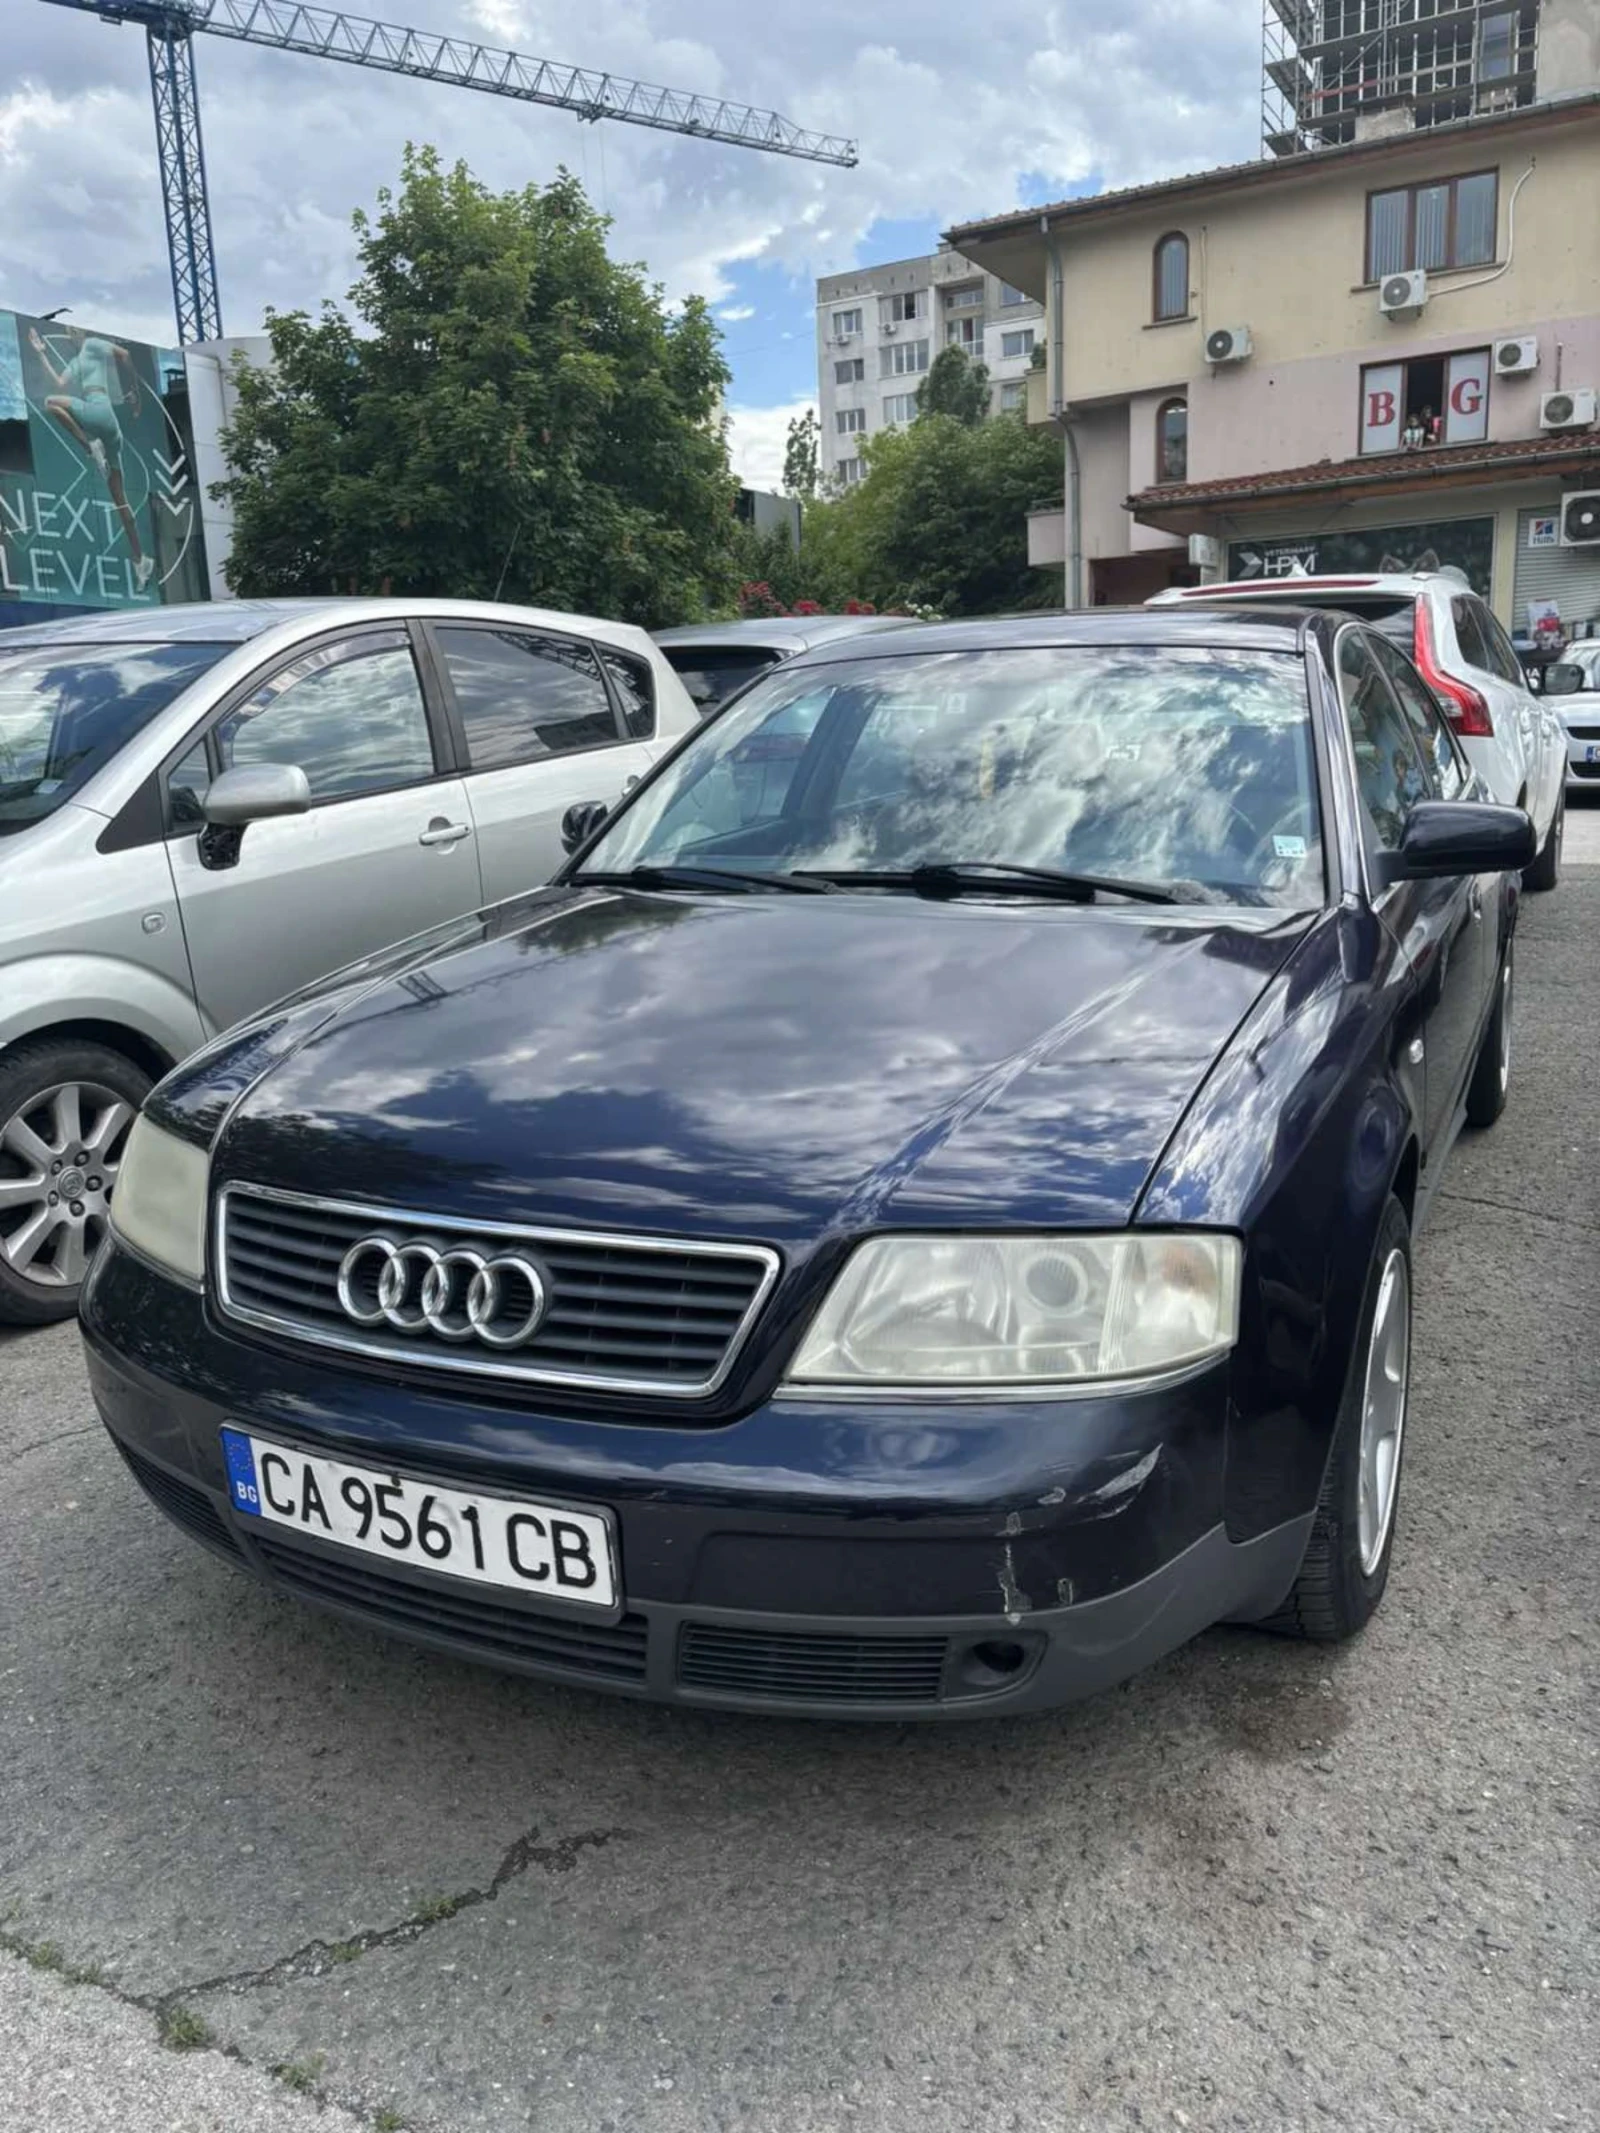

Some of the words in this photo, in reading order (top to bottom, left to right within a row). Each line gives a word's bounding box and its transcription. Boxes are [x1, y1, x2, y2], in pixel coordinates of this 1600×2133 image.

[1367, 391, 1396, 427] B
[1451, 378, 1483, 415] G
[0, 489, 121, 544] NEXT
[0, 545, 150, 600] LEVEL
[236, 1481, 258, 1503] BG
[261, 1452, 333, 1531] CA
[341, 1477, 485, 1569] 9561
[507, 1513, 597, 1589] CB
